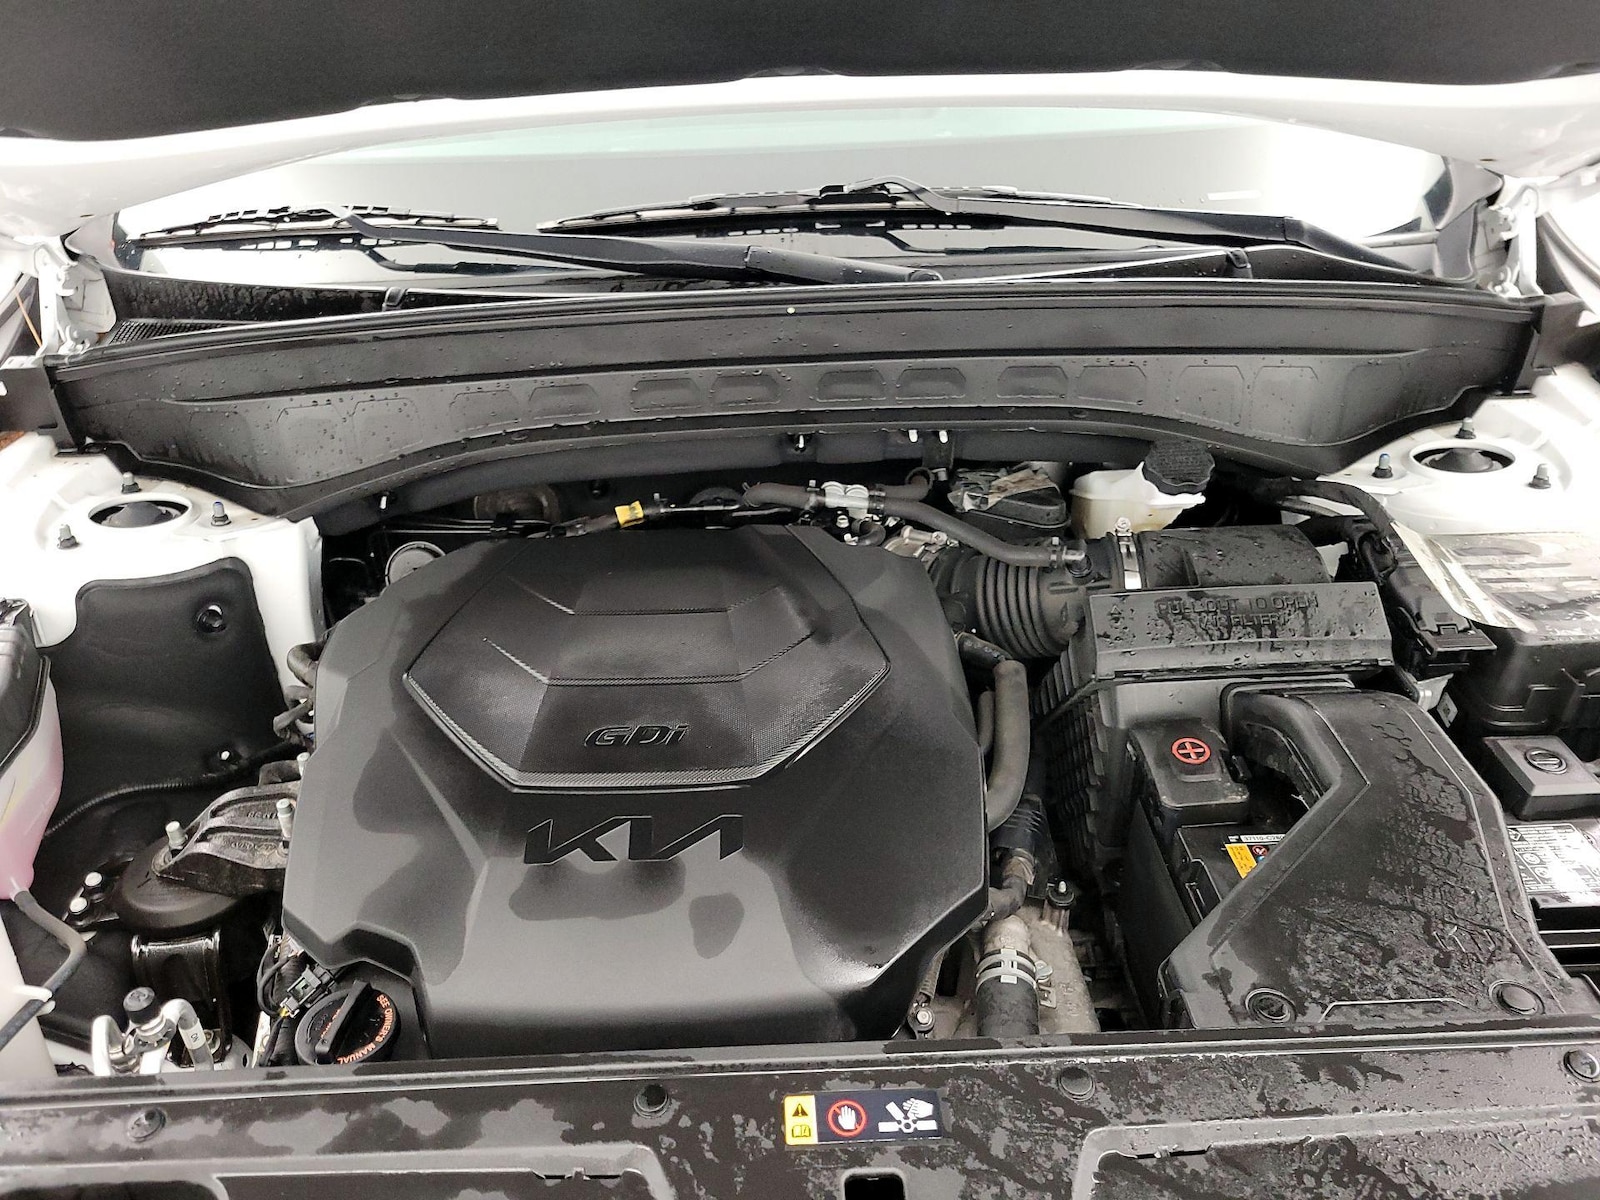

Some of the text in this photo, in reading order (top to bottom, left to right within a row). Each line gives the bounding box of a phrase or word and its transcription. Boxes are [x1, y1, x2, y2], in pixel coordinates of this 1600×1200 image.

[584, 723, 689, 747] GDi
[376, 994, 391, 1009] SEE
[336, 1042, 376, 1065] MANUAL
